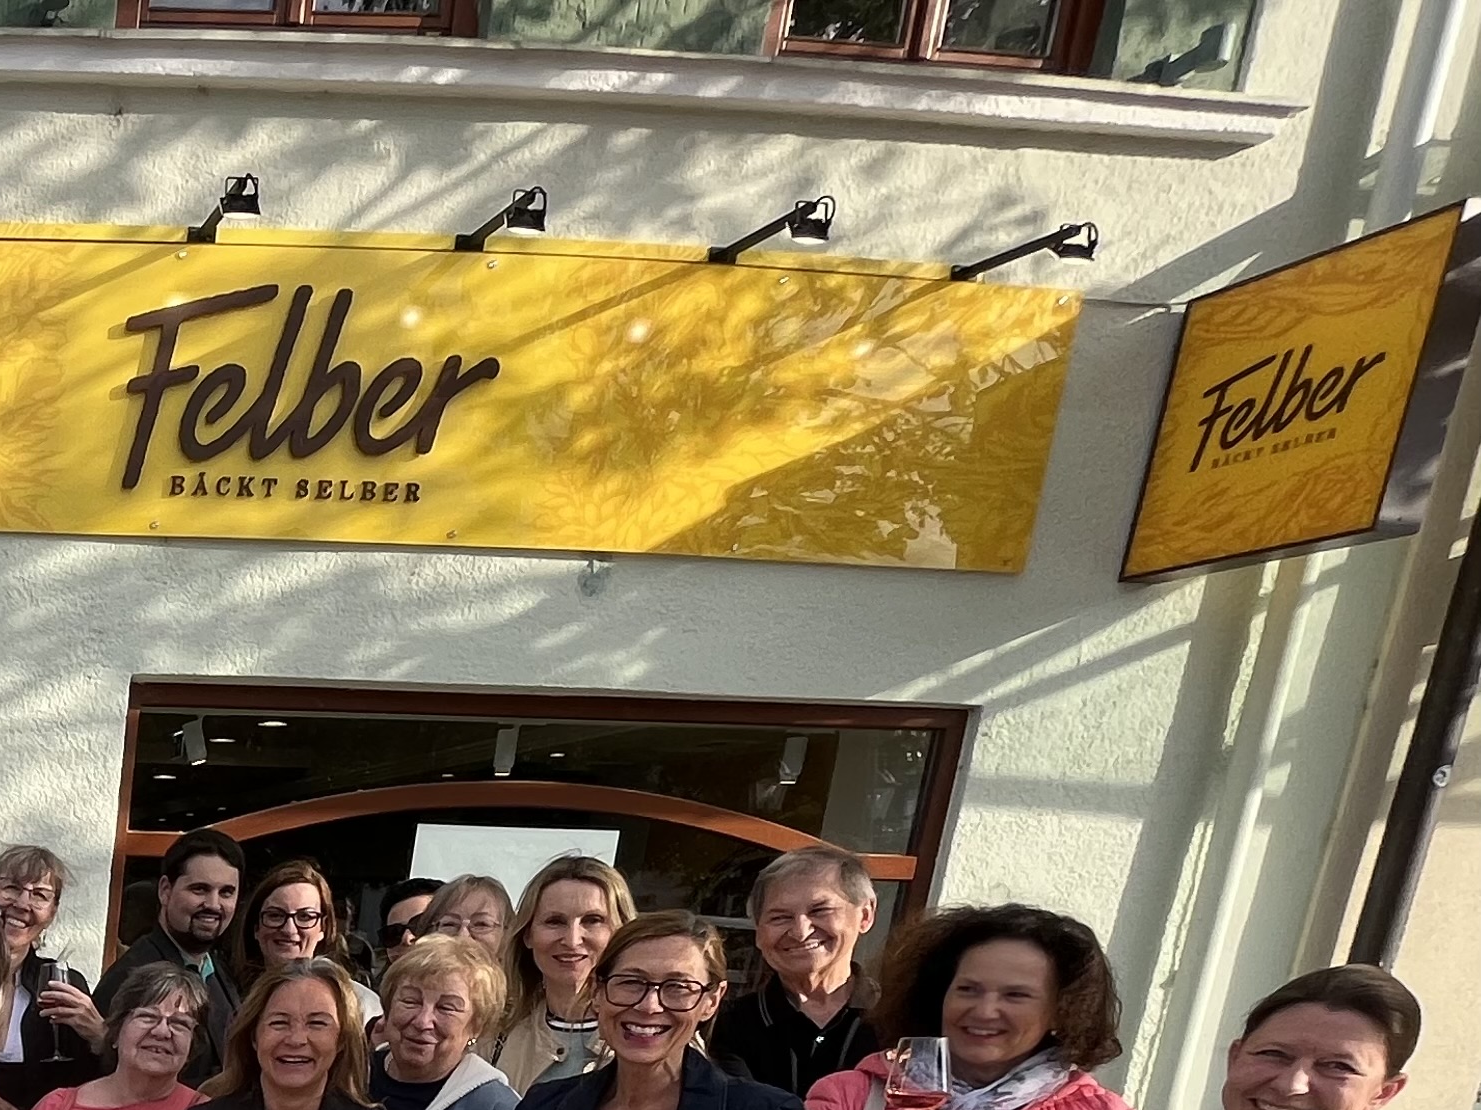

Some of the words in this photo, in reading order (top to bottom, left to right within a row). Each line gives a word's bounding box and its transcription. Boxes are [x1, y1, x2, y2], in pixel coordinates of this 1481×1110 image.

[121, 284, 500, 489] Felber
[1188, 344, 1386, 473] Felber
[295, 479, 421, 503] SELBER
